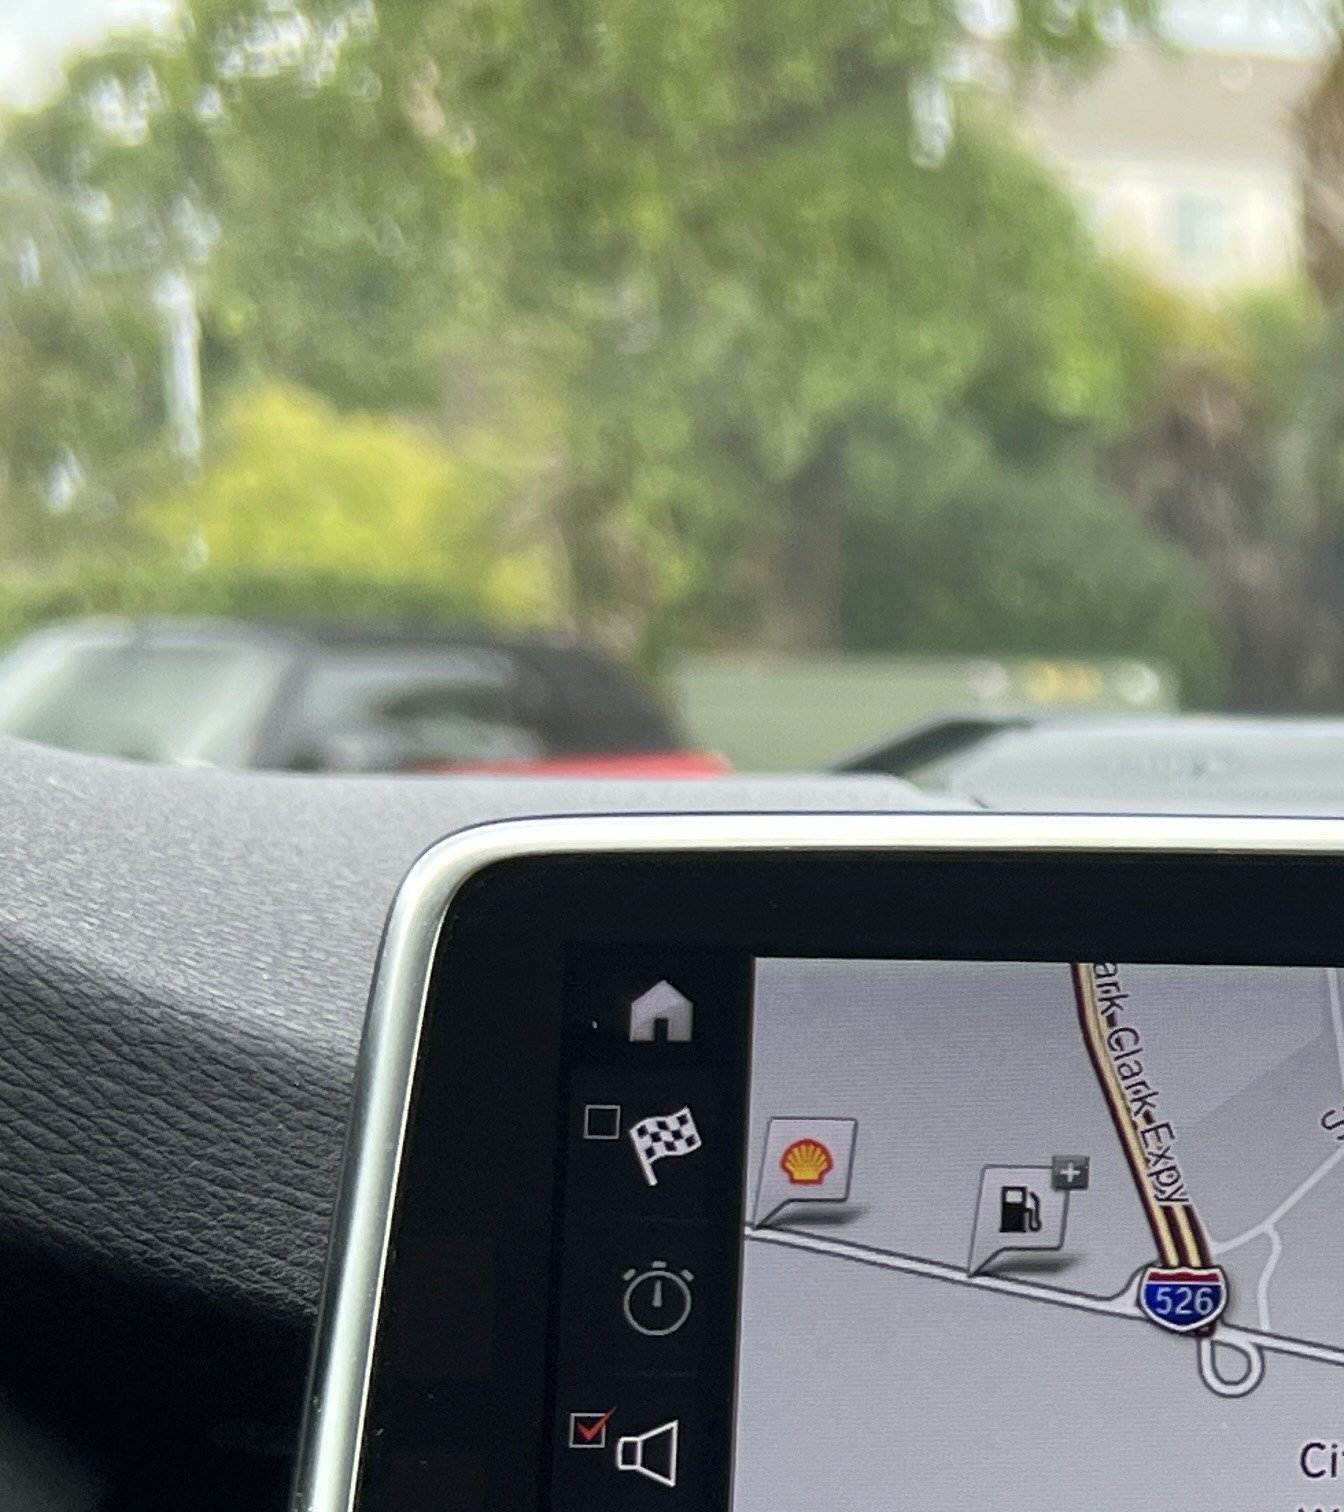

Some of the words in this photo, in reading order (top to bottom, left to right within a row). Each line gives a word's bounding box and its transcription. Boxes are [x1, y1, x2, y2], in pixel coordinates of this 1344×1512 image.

[1107, 1027, 1159, 1117] Clark
[1141, 1122, 1190, 1204] Expy
[1154, 1285, 1214, 1316] 526
